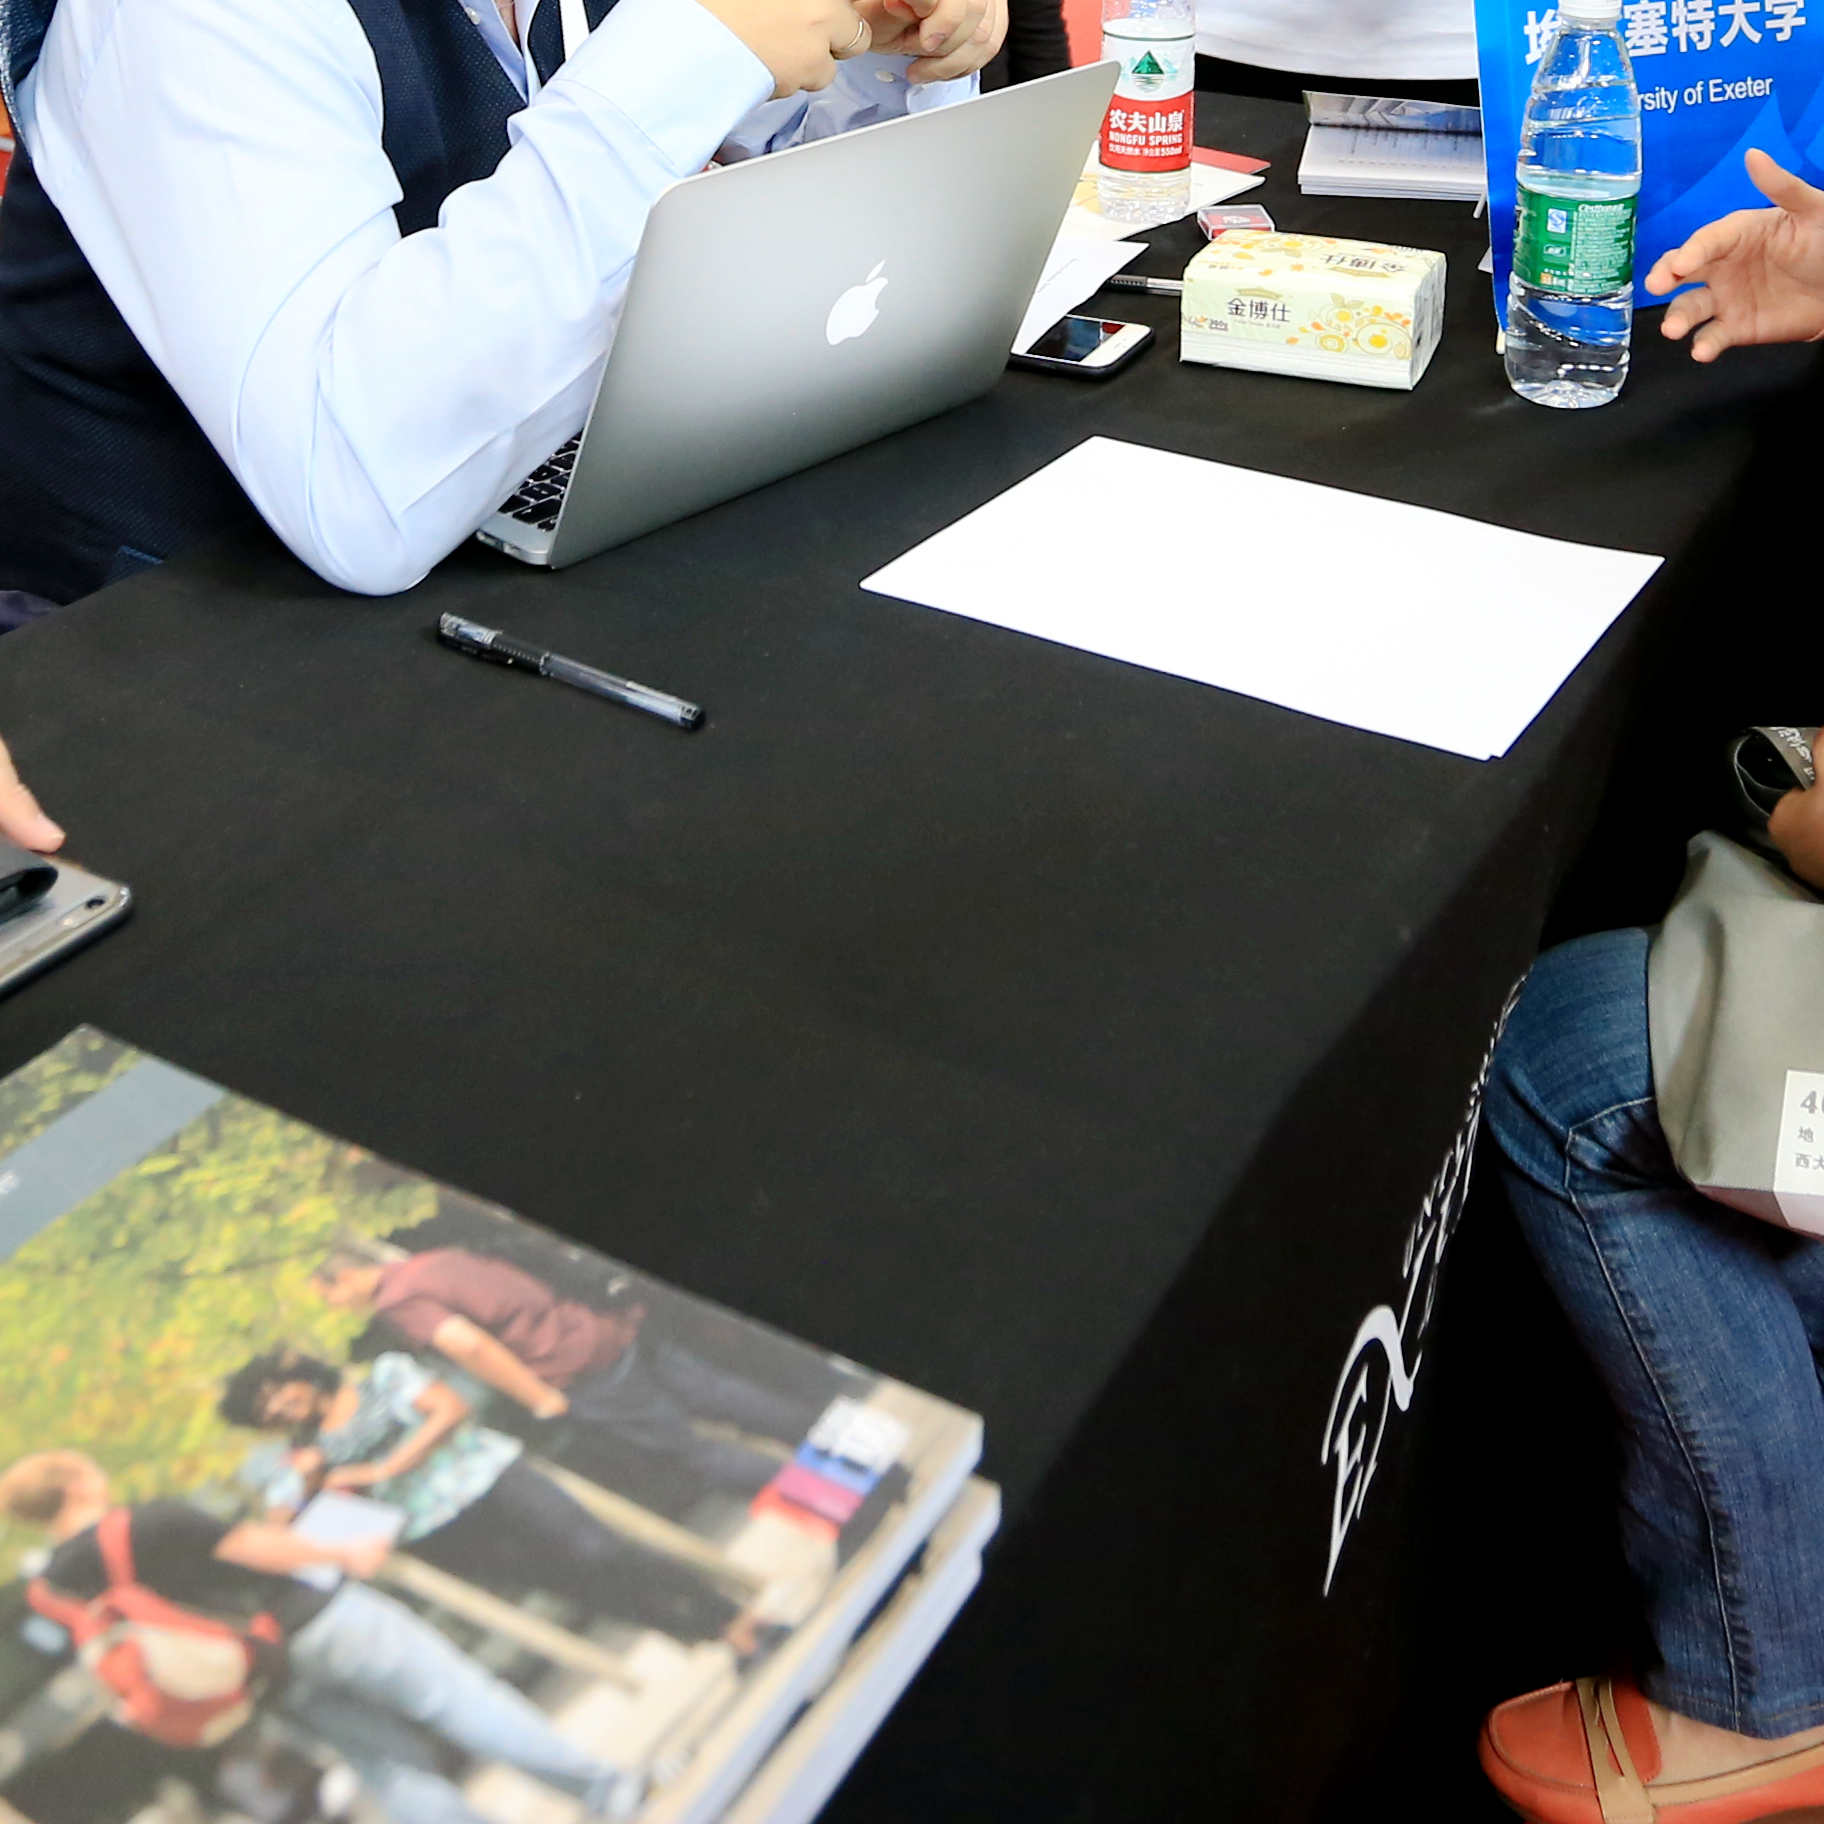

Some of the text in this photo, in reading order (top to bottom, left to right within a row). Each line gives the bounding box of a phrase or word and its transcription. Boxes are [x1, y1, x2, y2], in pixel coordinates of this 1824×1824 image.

[1637, 76, 1774, 114] rsity of Exeter
[1109, 109, 1184, 133] 农夫山泉
[1149, 133, 1183, 146] SPRING
[1227, 297, 1291, 323] 金博仕
